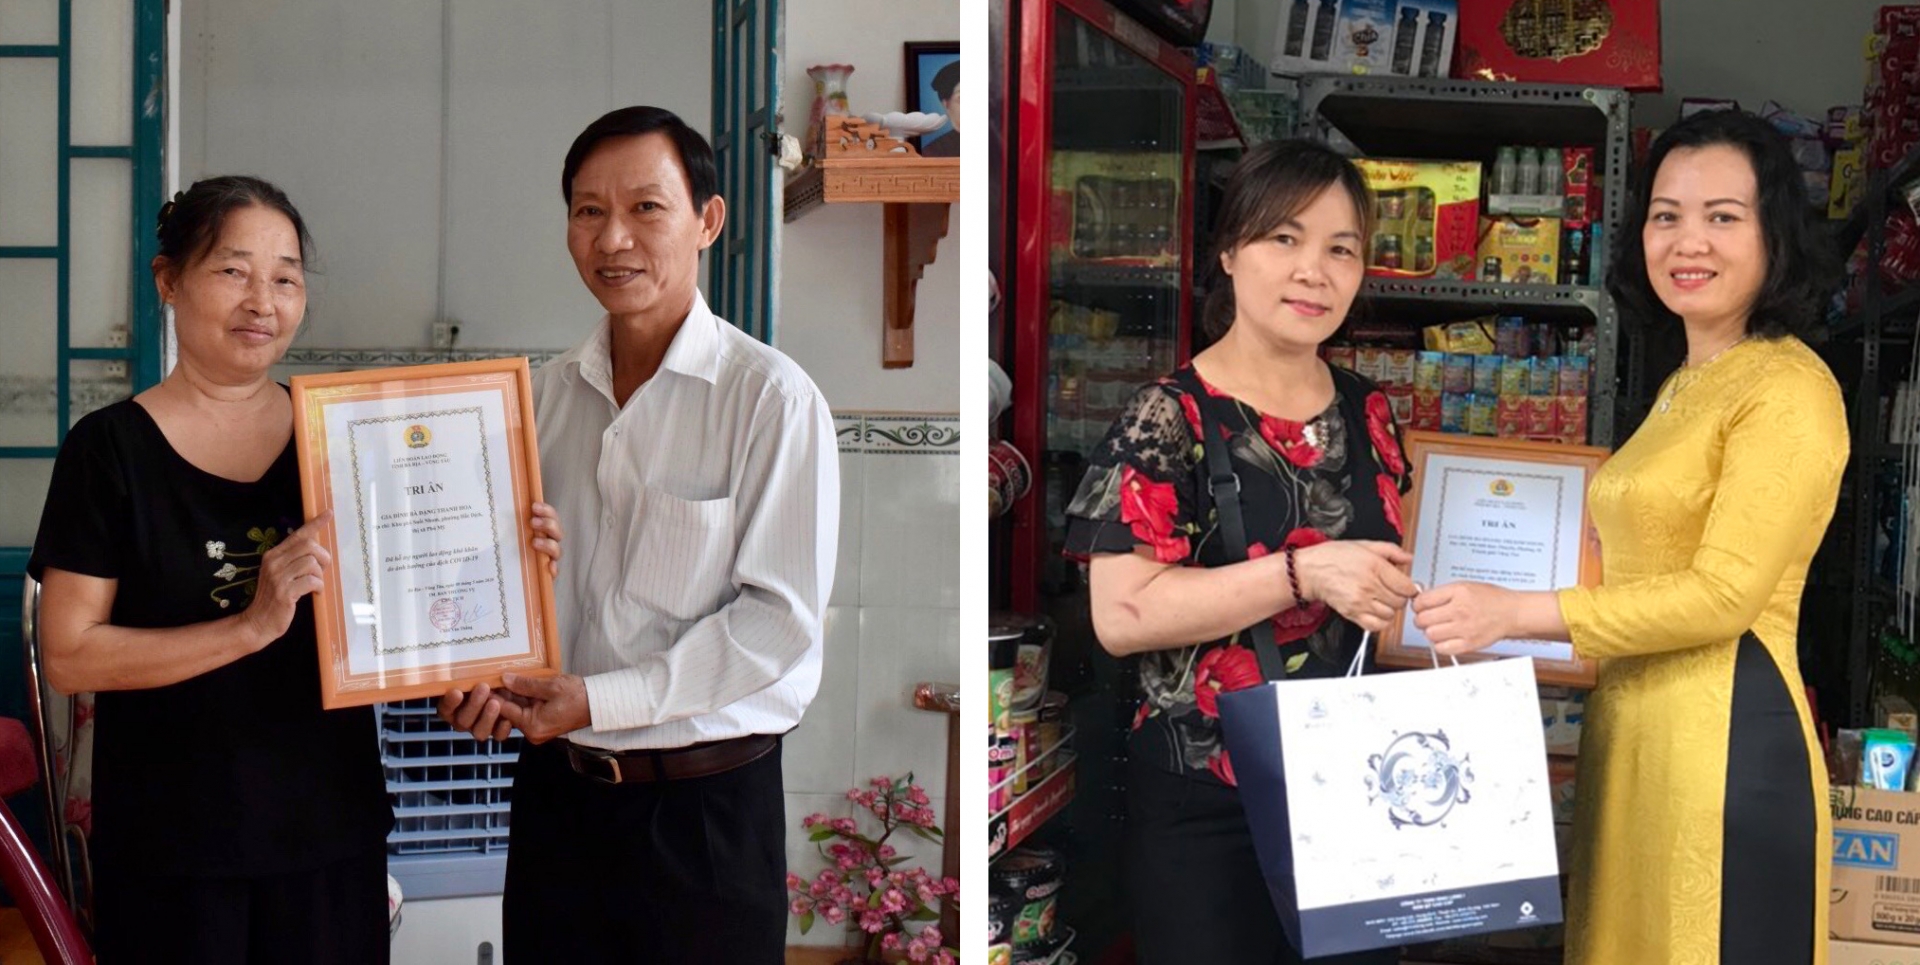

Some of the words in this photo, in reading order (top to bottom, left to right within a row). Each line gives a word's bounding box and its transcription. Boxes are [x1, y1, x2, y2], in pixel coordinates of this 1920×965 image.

[403, 485, 425, 496] TRI
[428, 481, 444, 494] ÂN
[1865, 807, 1893, 824] CAO
